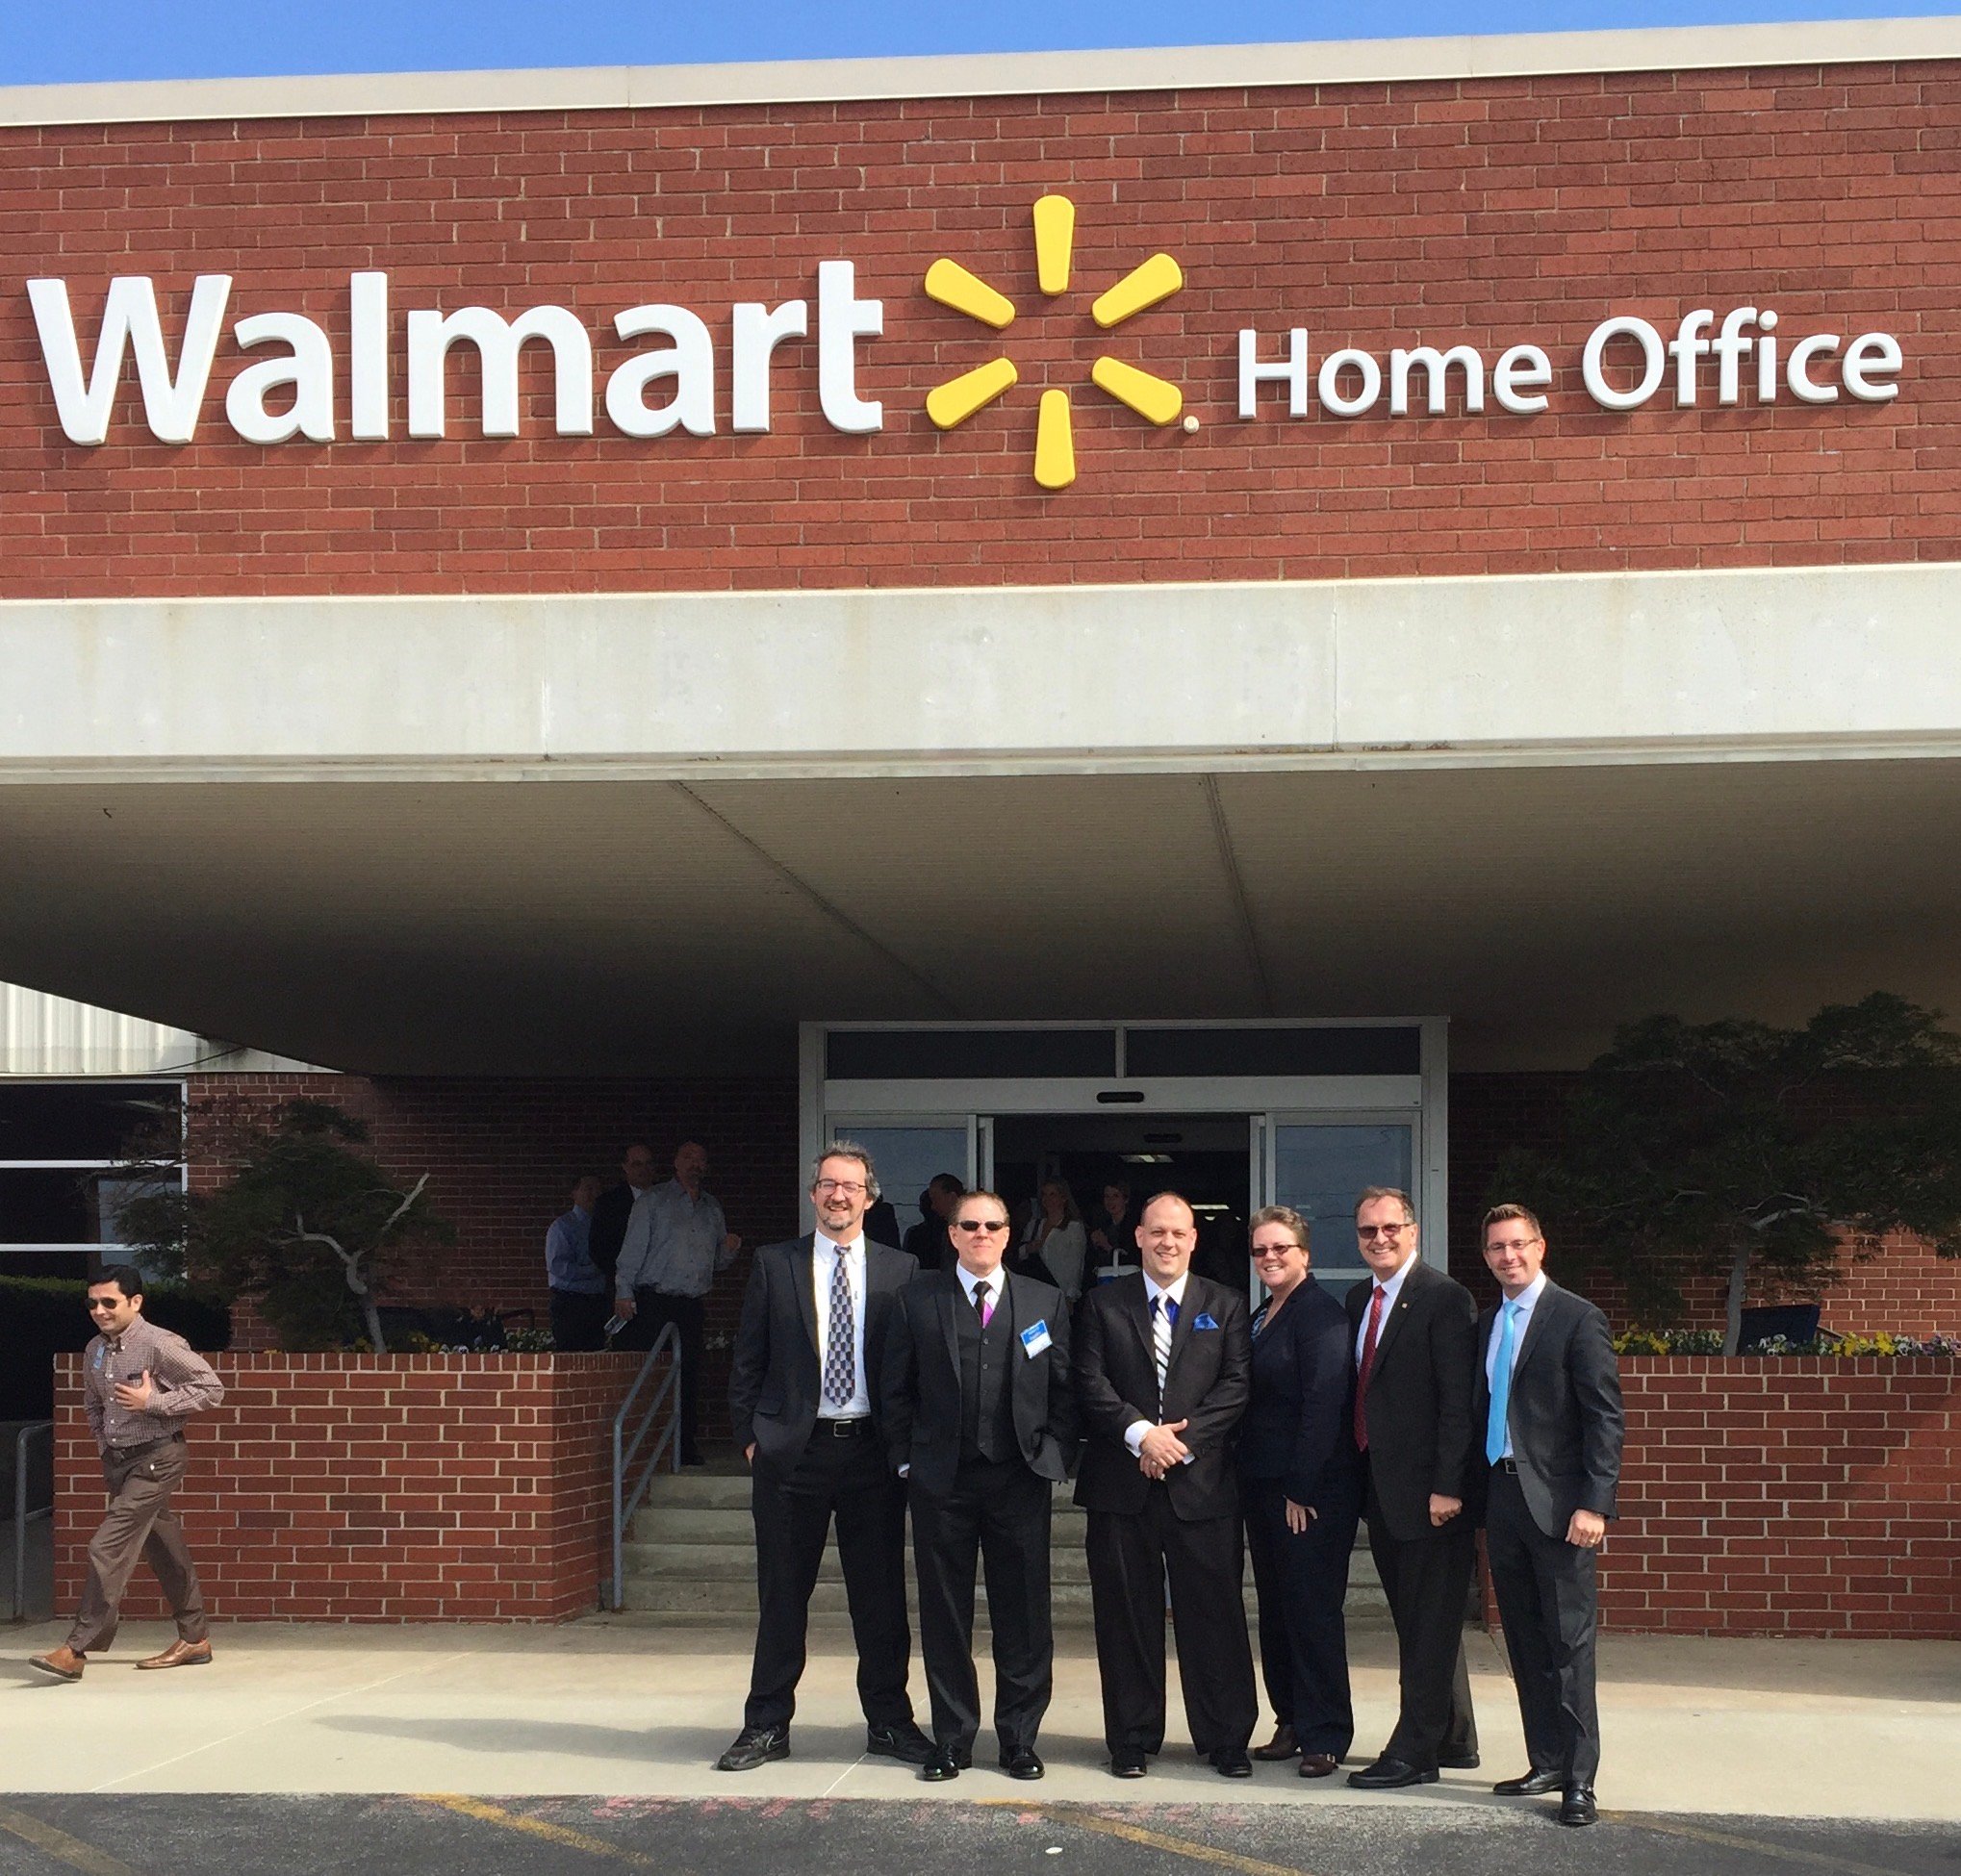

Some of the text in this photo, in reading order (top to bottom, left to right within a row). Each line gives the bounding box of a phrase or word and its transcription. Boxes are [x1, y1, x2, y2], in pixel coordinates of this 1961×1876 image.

[26, 260, 1904, 446] Walmart Home Office
